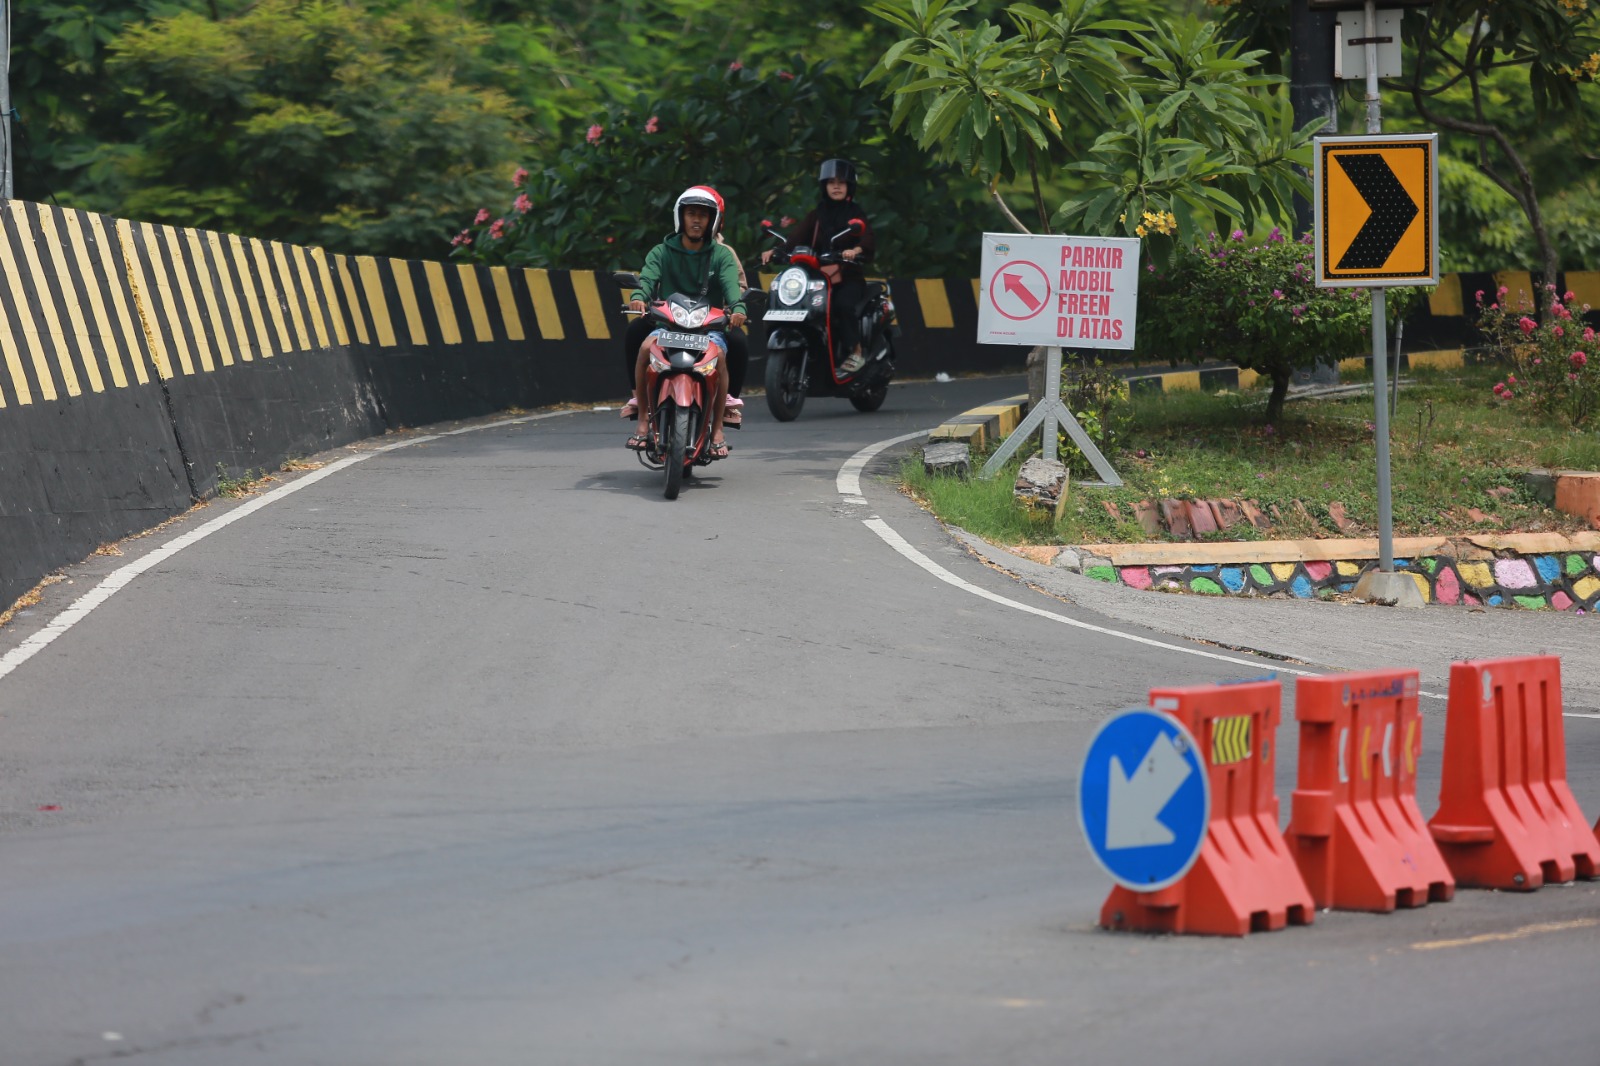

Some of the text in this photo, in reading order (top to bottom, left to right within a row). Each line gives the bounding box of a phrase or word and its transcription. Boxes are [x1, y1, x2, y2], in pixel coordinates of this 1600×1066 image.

[1061, 246, 1123, 269] PARKIR
[1059, 270, 1114, 292] MOBIL
[1058, 293, 1110, 316] FREEN
[1057, 317, 1123, 340] DI ATAS
